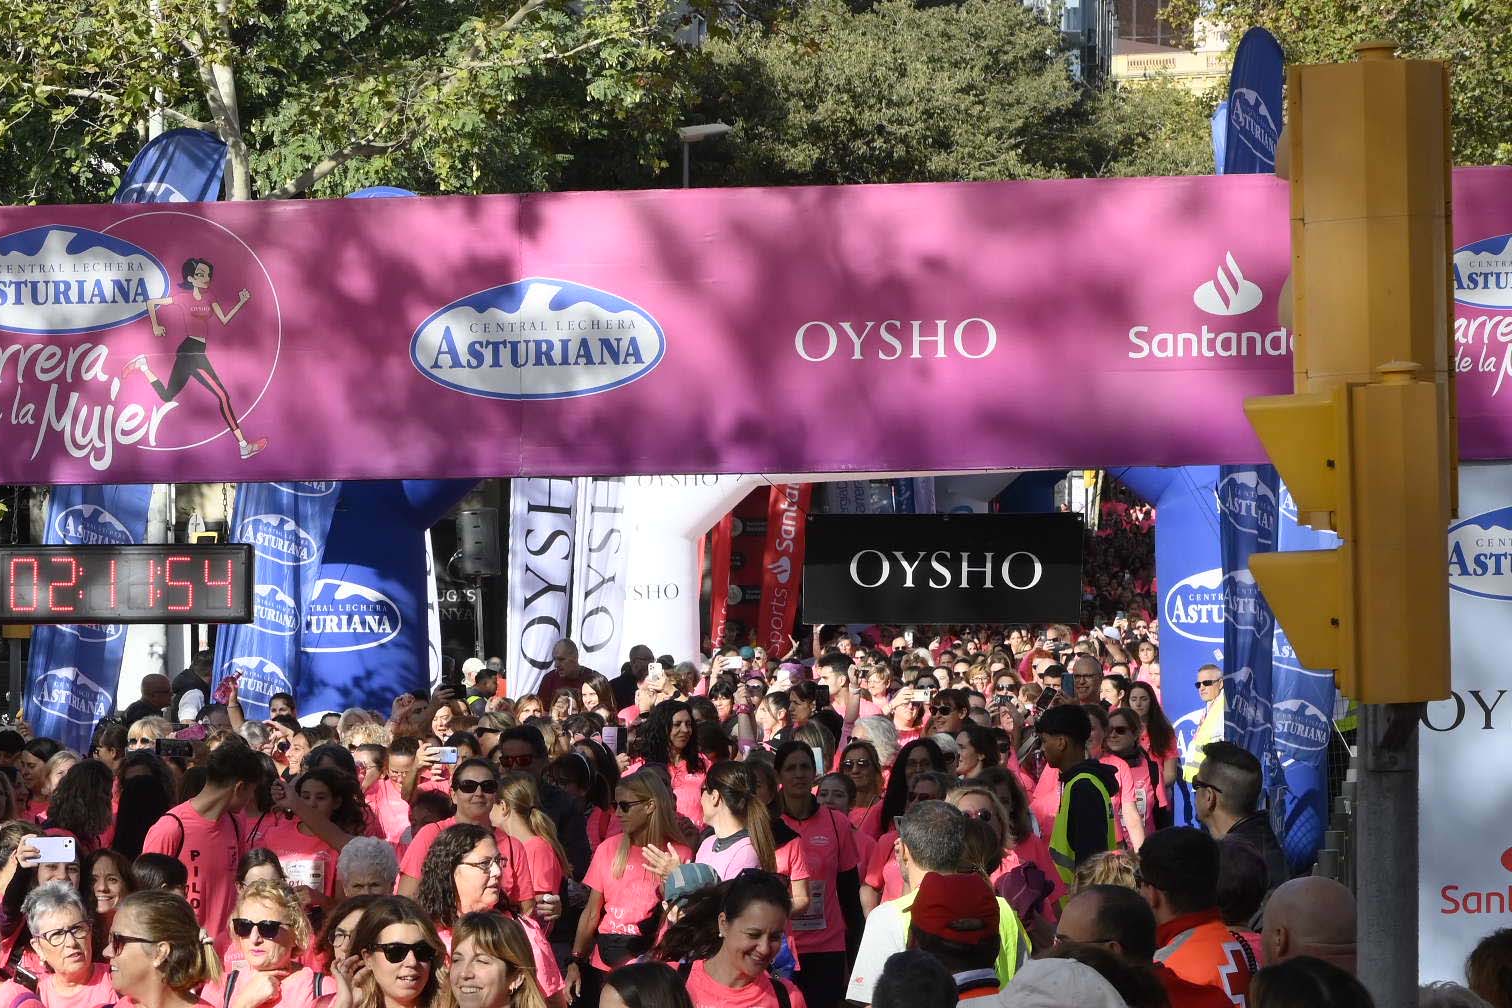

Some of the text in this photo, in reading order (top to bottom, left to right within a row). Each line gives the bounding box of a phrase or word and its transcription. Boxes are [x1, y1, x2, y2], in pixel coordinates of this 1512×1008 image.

[71, 261, 145, 273] LECHERA
[430, 325, 646, 369] ASTURIANA
[469, 318, 637, 334] CENTRAL LECHERA
[794, 317, 998, 362] OYSHO
[10, 386, 36, 426] la
[30, 377, 179, 471] Mujer
[9, 556, 232, 612] 02:11:54
[849, 549, 1043, 590] OYSHO
